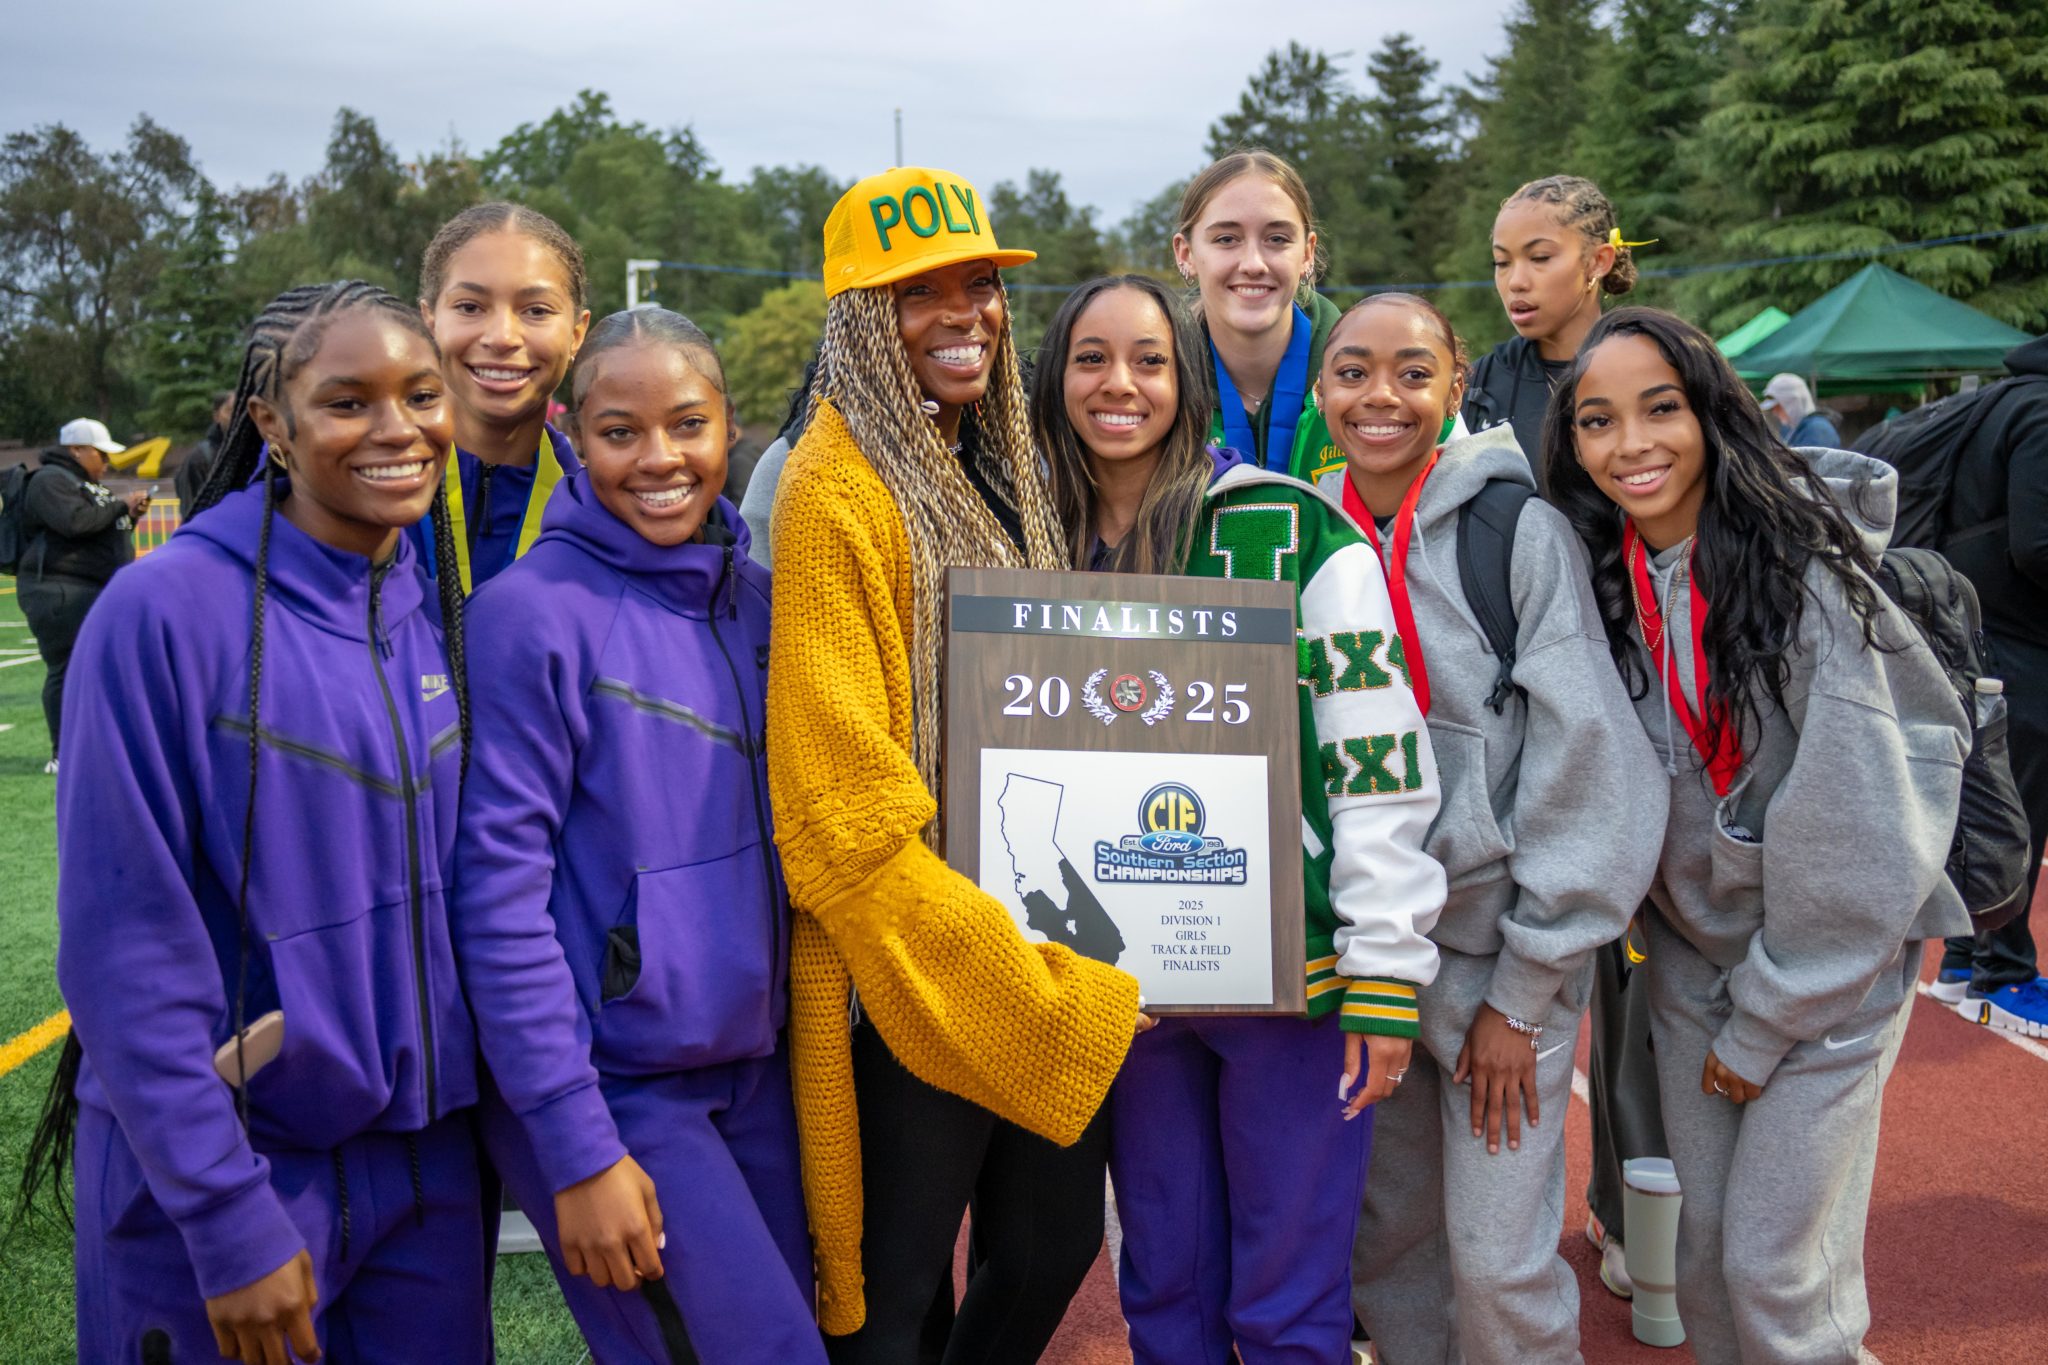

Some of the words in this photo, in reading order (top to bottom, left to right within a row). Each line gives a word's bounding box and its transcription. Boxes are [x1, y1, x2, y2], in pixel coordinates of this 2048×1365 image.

[869, 182, 980, 251] POLY
[1012, 603, 1238, 637] FINALISTS
[1148, 791, 1196, 831] CIF
[1123, 838, 1137, 847] Est.
[1151, 833, 1192, 852] Ford
[1097, 844, 1175, 868] Southern
[1183, 851, 1245, 869] Section
[1097, 863, 1245, 883] CHAMPIONSHIPS
[1178, 899, 1204, 911] 2025
[1161, 915, 1213, 925] DIVISION
[1175, 930, 1207, 941] GIRLS
[1151, 944, 1188, 955] TRACK
[1189, 944, 1199, 955] &
[1200, 945, 1231, 955] FIELD
[1163, 960, 1220, 971] FINALISTS
